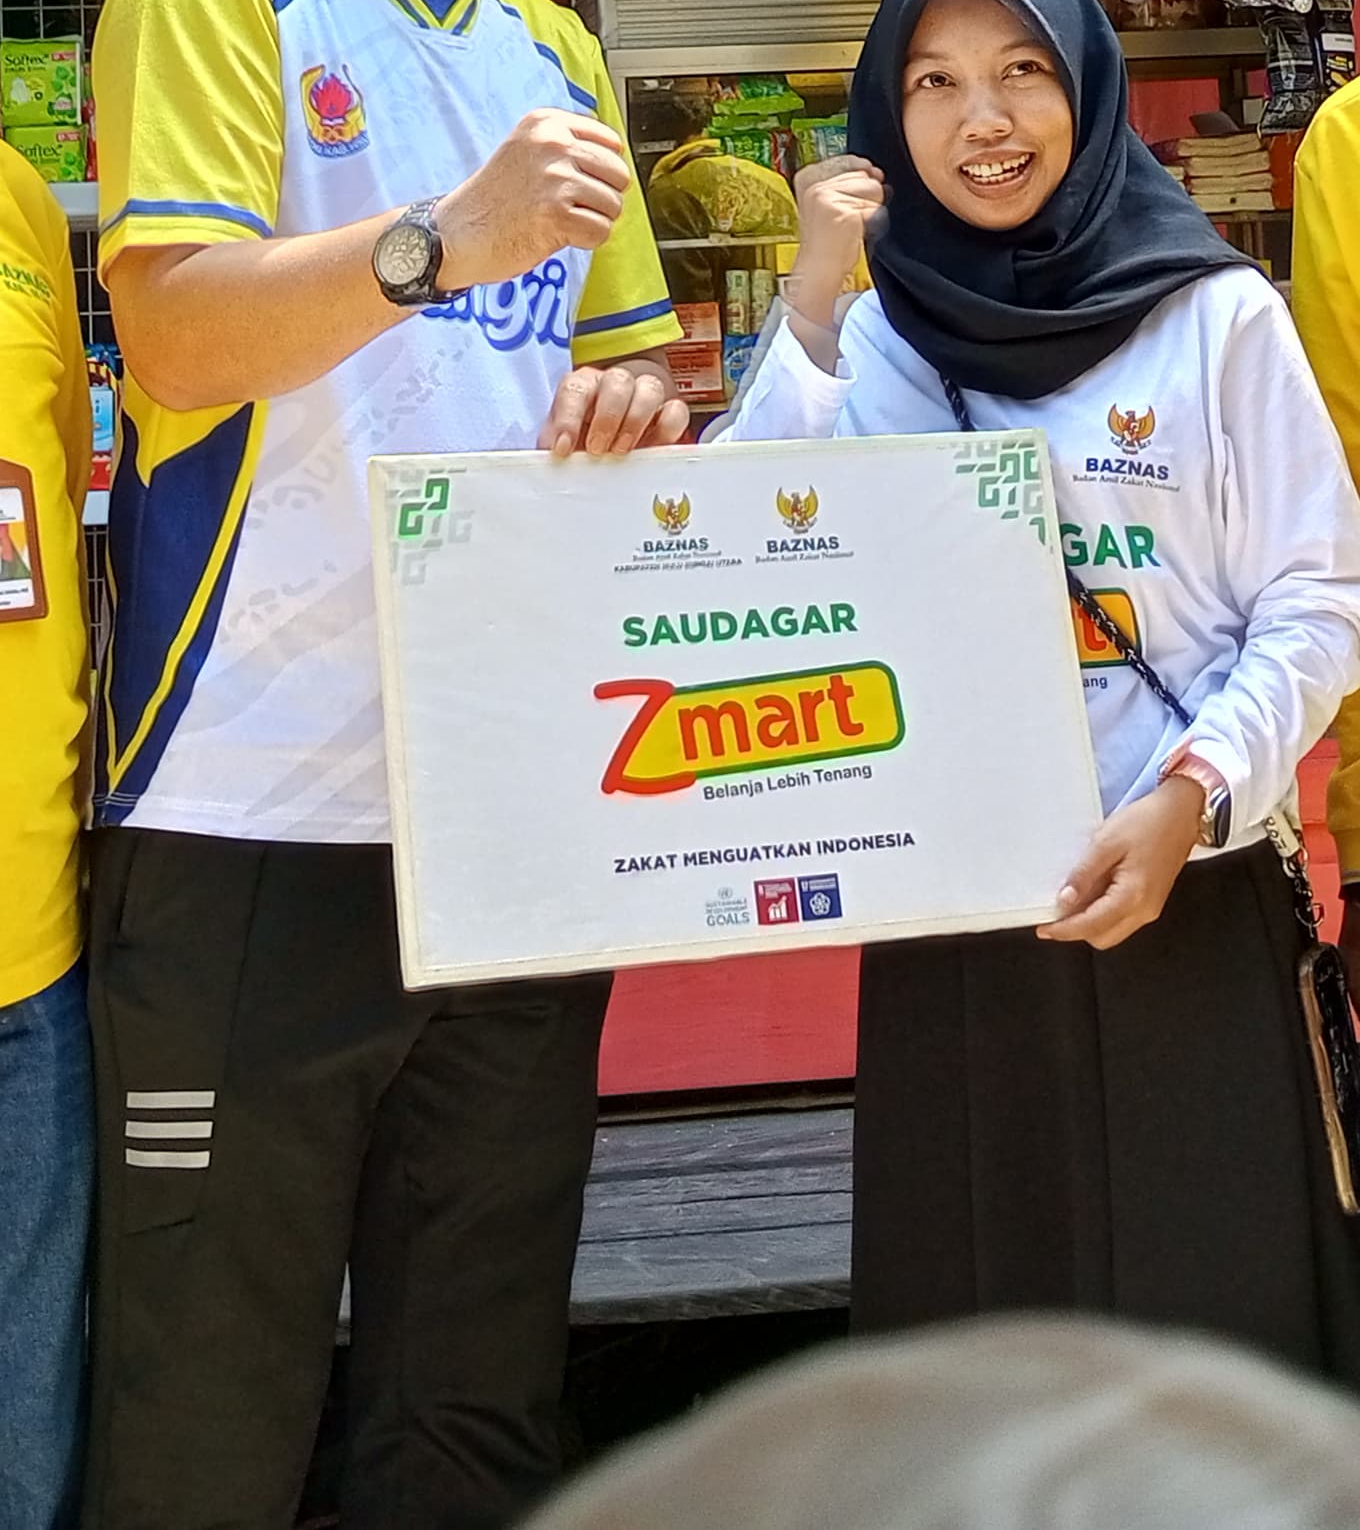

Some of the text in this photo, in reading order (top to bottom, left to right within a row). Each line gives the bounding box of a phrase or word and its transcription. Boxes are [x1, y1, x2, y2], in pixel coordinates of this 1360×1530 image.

[1085, 458, 1170, 481] BAZNAS
[643, 537, 710, 554] BAZNAS
[766, 536, 840, 554] BAZNAS
[622, 602, 858, 647] SAUDAGAR
[594, 674, 865, 795] Zmart
[703, 764, 873, 801] Belanja Lebih Tenang
[614, 832, 916, 874] ZAKAT MENGUATKAN INDONESIA
[706, 912, 751, 927] GOALS
